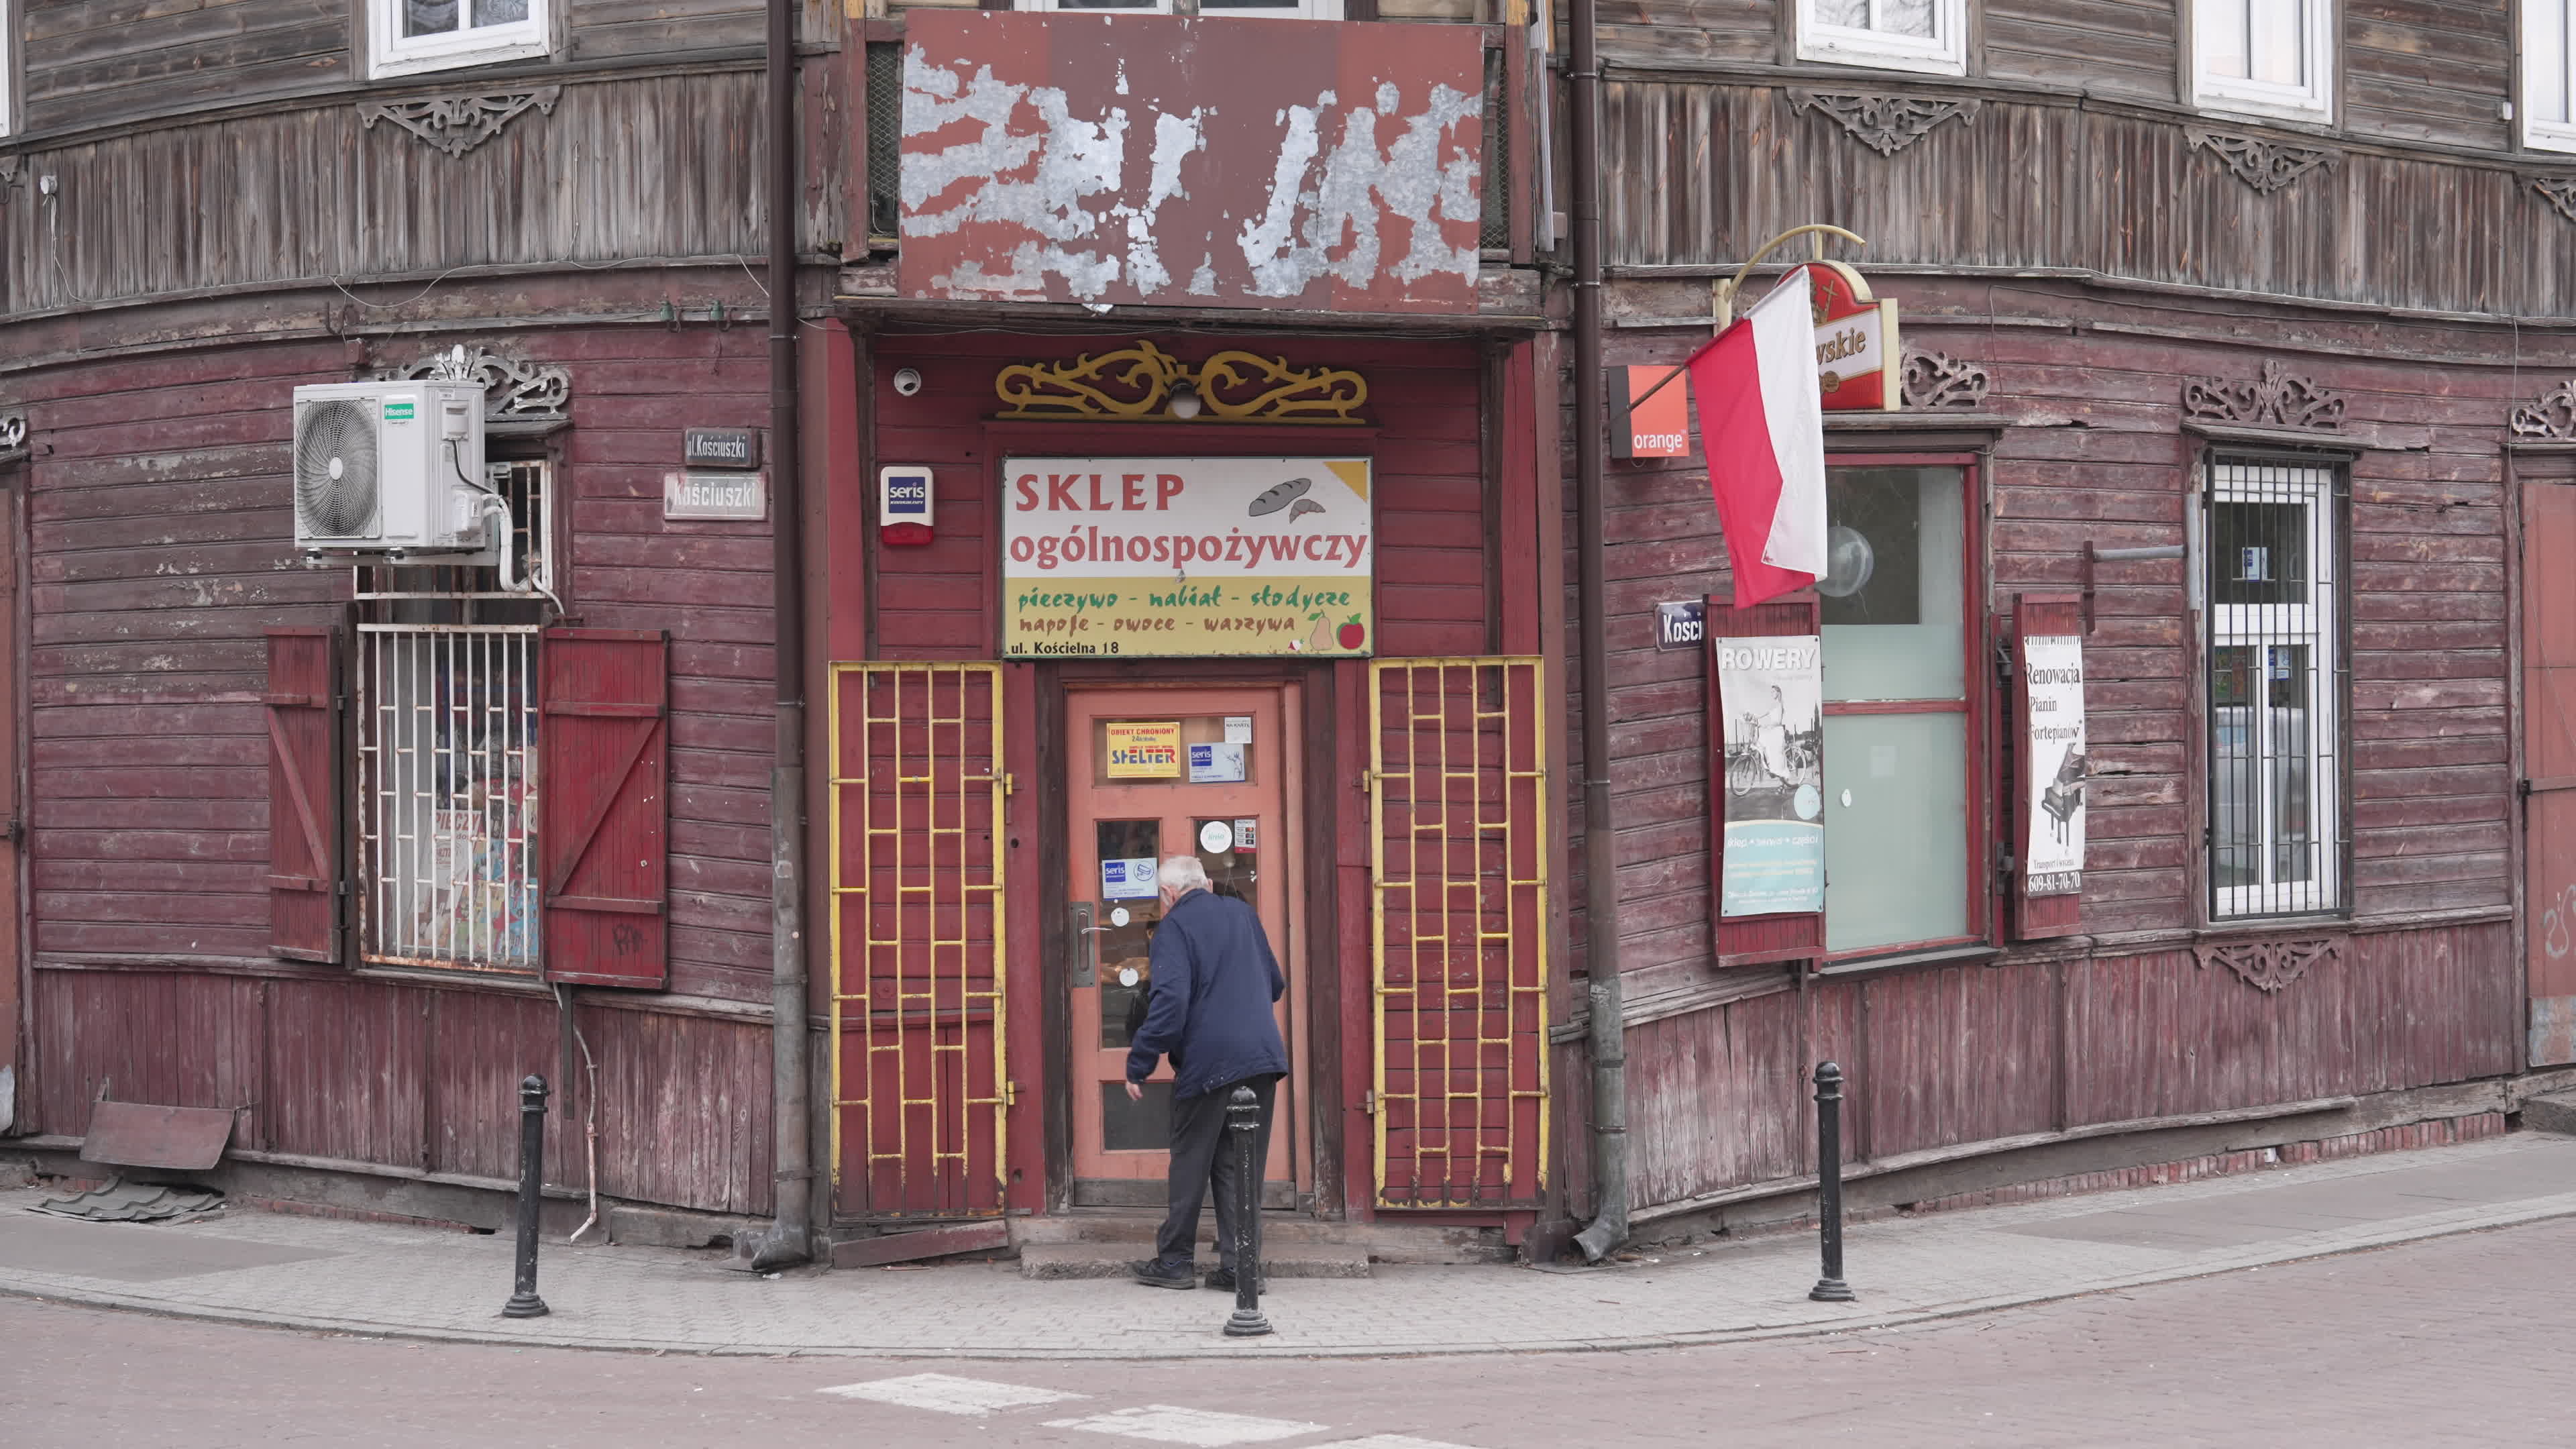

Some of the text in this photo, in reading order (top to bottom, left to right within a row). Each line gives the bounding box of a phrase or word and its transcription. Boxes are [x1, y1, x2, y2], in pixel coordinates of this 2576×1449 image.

[1816, 327, 1866, 365] yskie
[386, 407, 413, 416] Hisense
[1633, 435, 1682, 453] orange
[674, 482, 755, 507] Kościuszki
[890, 482, 924, 498] seris
[1015, 474, 1185, 511] SKLEP
[1010, 525, 1367, 570] ogólnospożywczy
[1018, 585, 1350, 613] pieczywo nabiał słodycze
[1020, 614, 1295, 637] napoje owoce warzywa
[1664, 611, 1702, 643] Kości
[1011, 642, 1119, 655] ul. Kościelna 18
[1722, 647, 1816, 670] ROWERY
[2027, 662, 2081, 690] Renowacja
[2030, 696, 2057, 712] Pianin
[1136, 728, 1174, 736] CHRONIONY
[1192, 749, 1211, 758] seris
[1106, 865, 1125, 874] seris
[2029, 871, 2080, 892] 609-81-70-70
